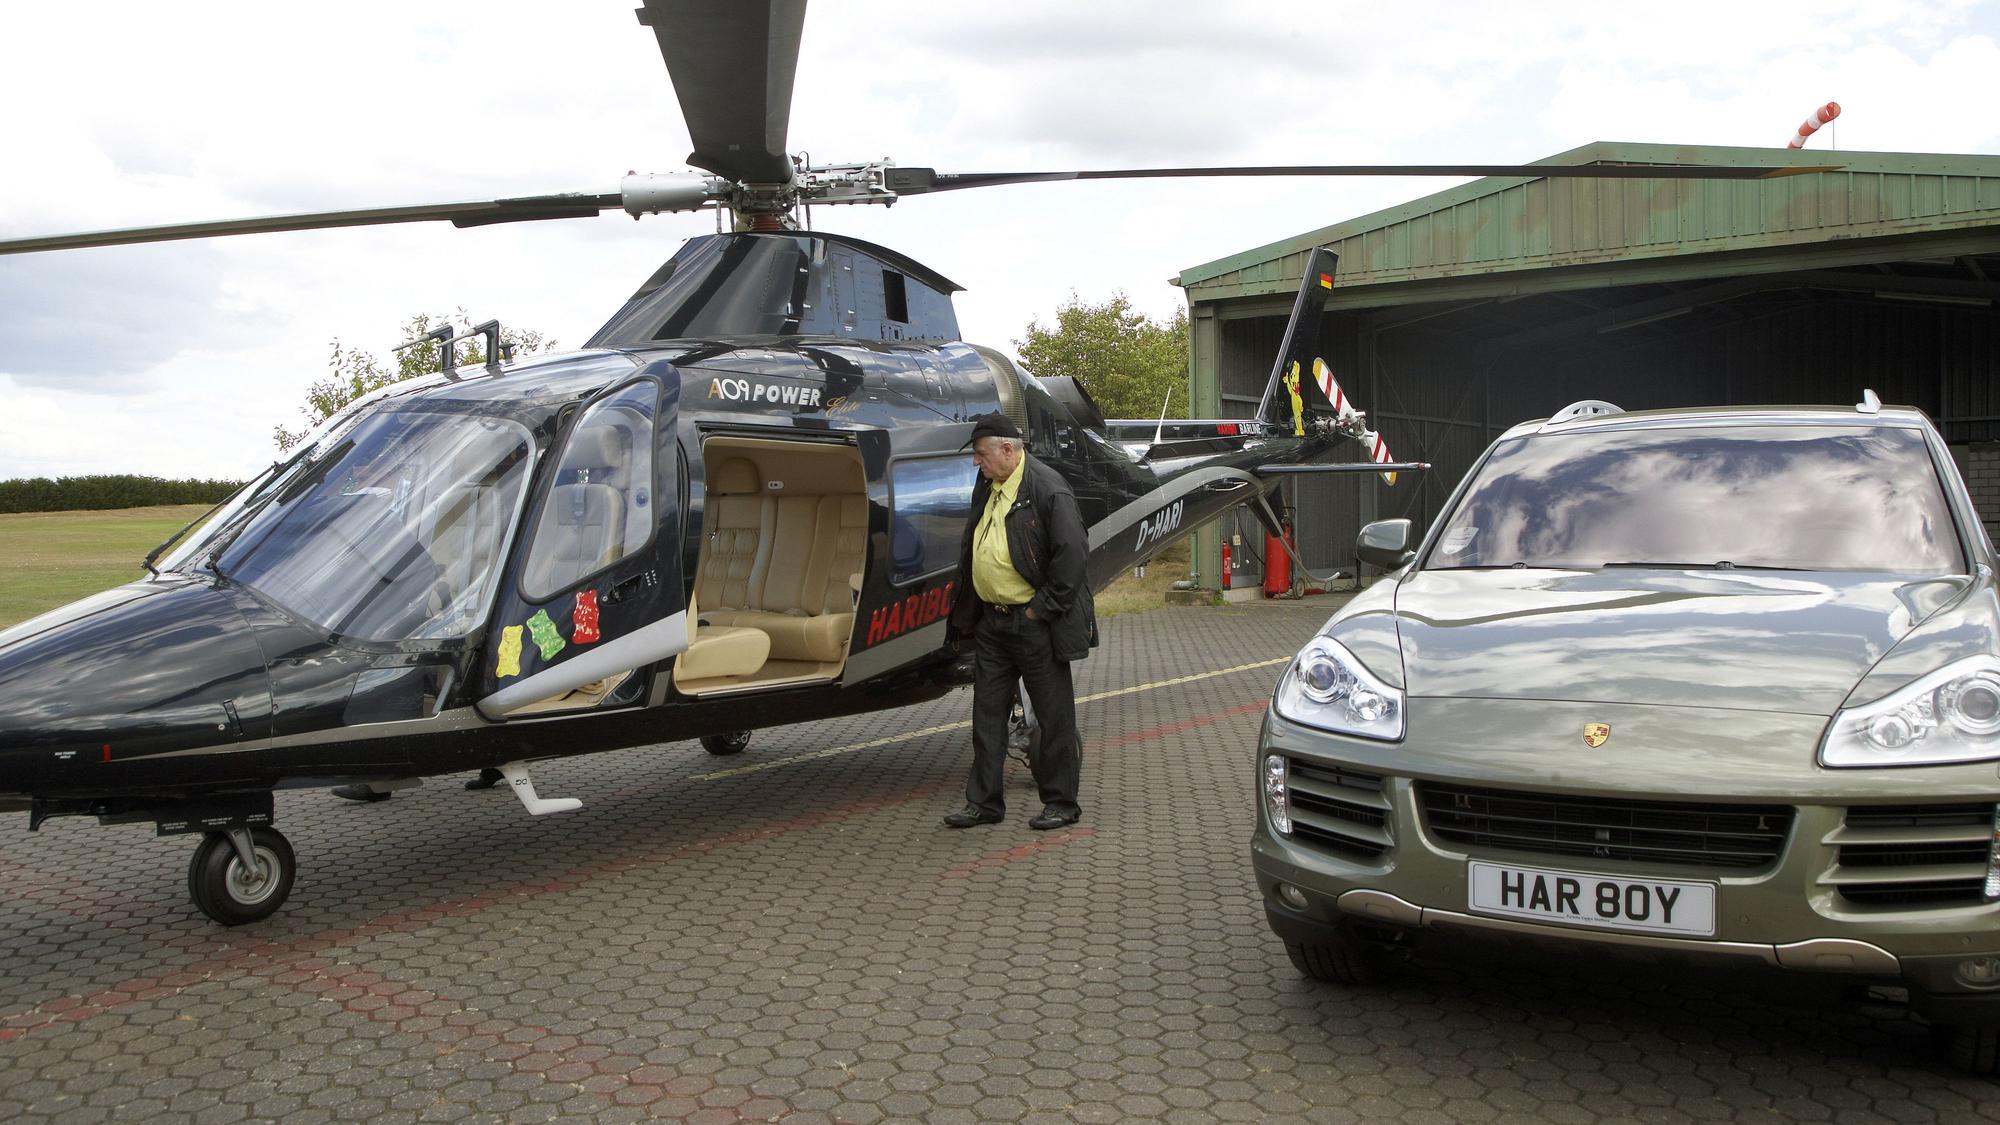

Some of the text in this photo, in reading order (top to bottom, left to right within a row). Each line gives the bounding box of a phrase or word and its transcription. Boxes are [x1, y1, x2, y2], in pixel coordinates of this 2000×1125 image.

[753, 383, 821, 407] POWER
[1135, 499, 1183, 552] D-HARI
[1501, 870, 1581, 915] HAR
